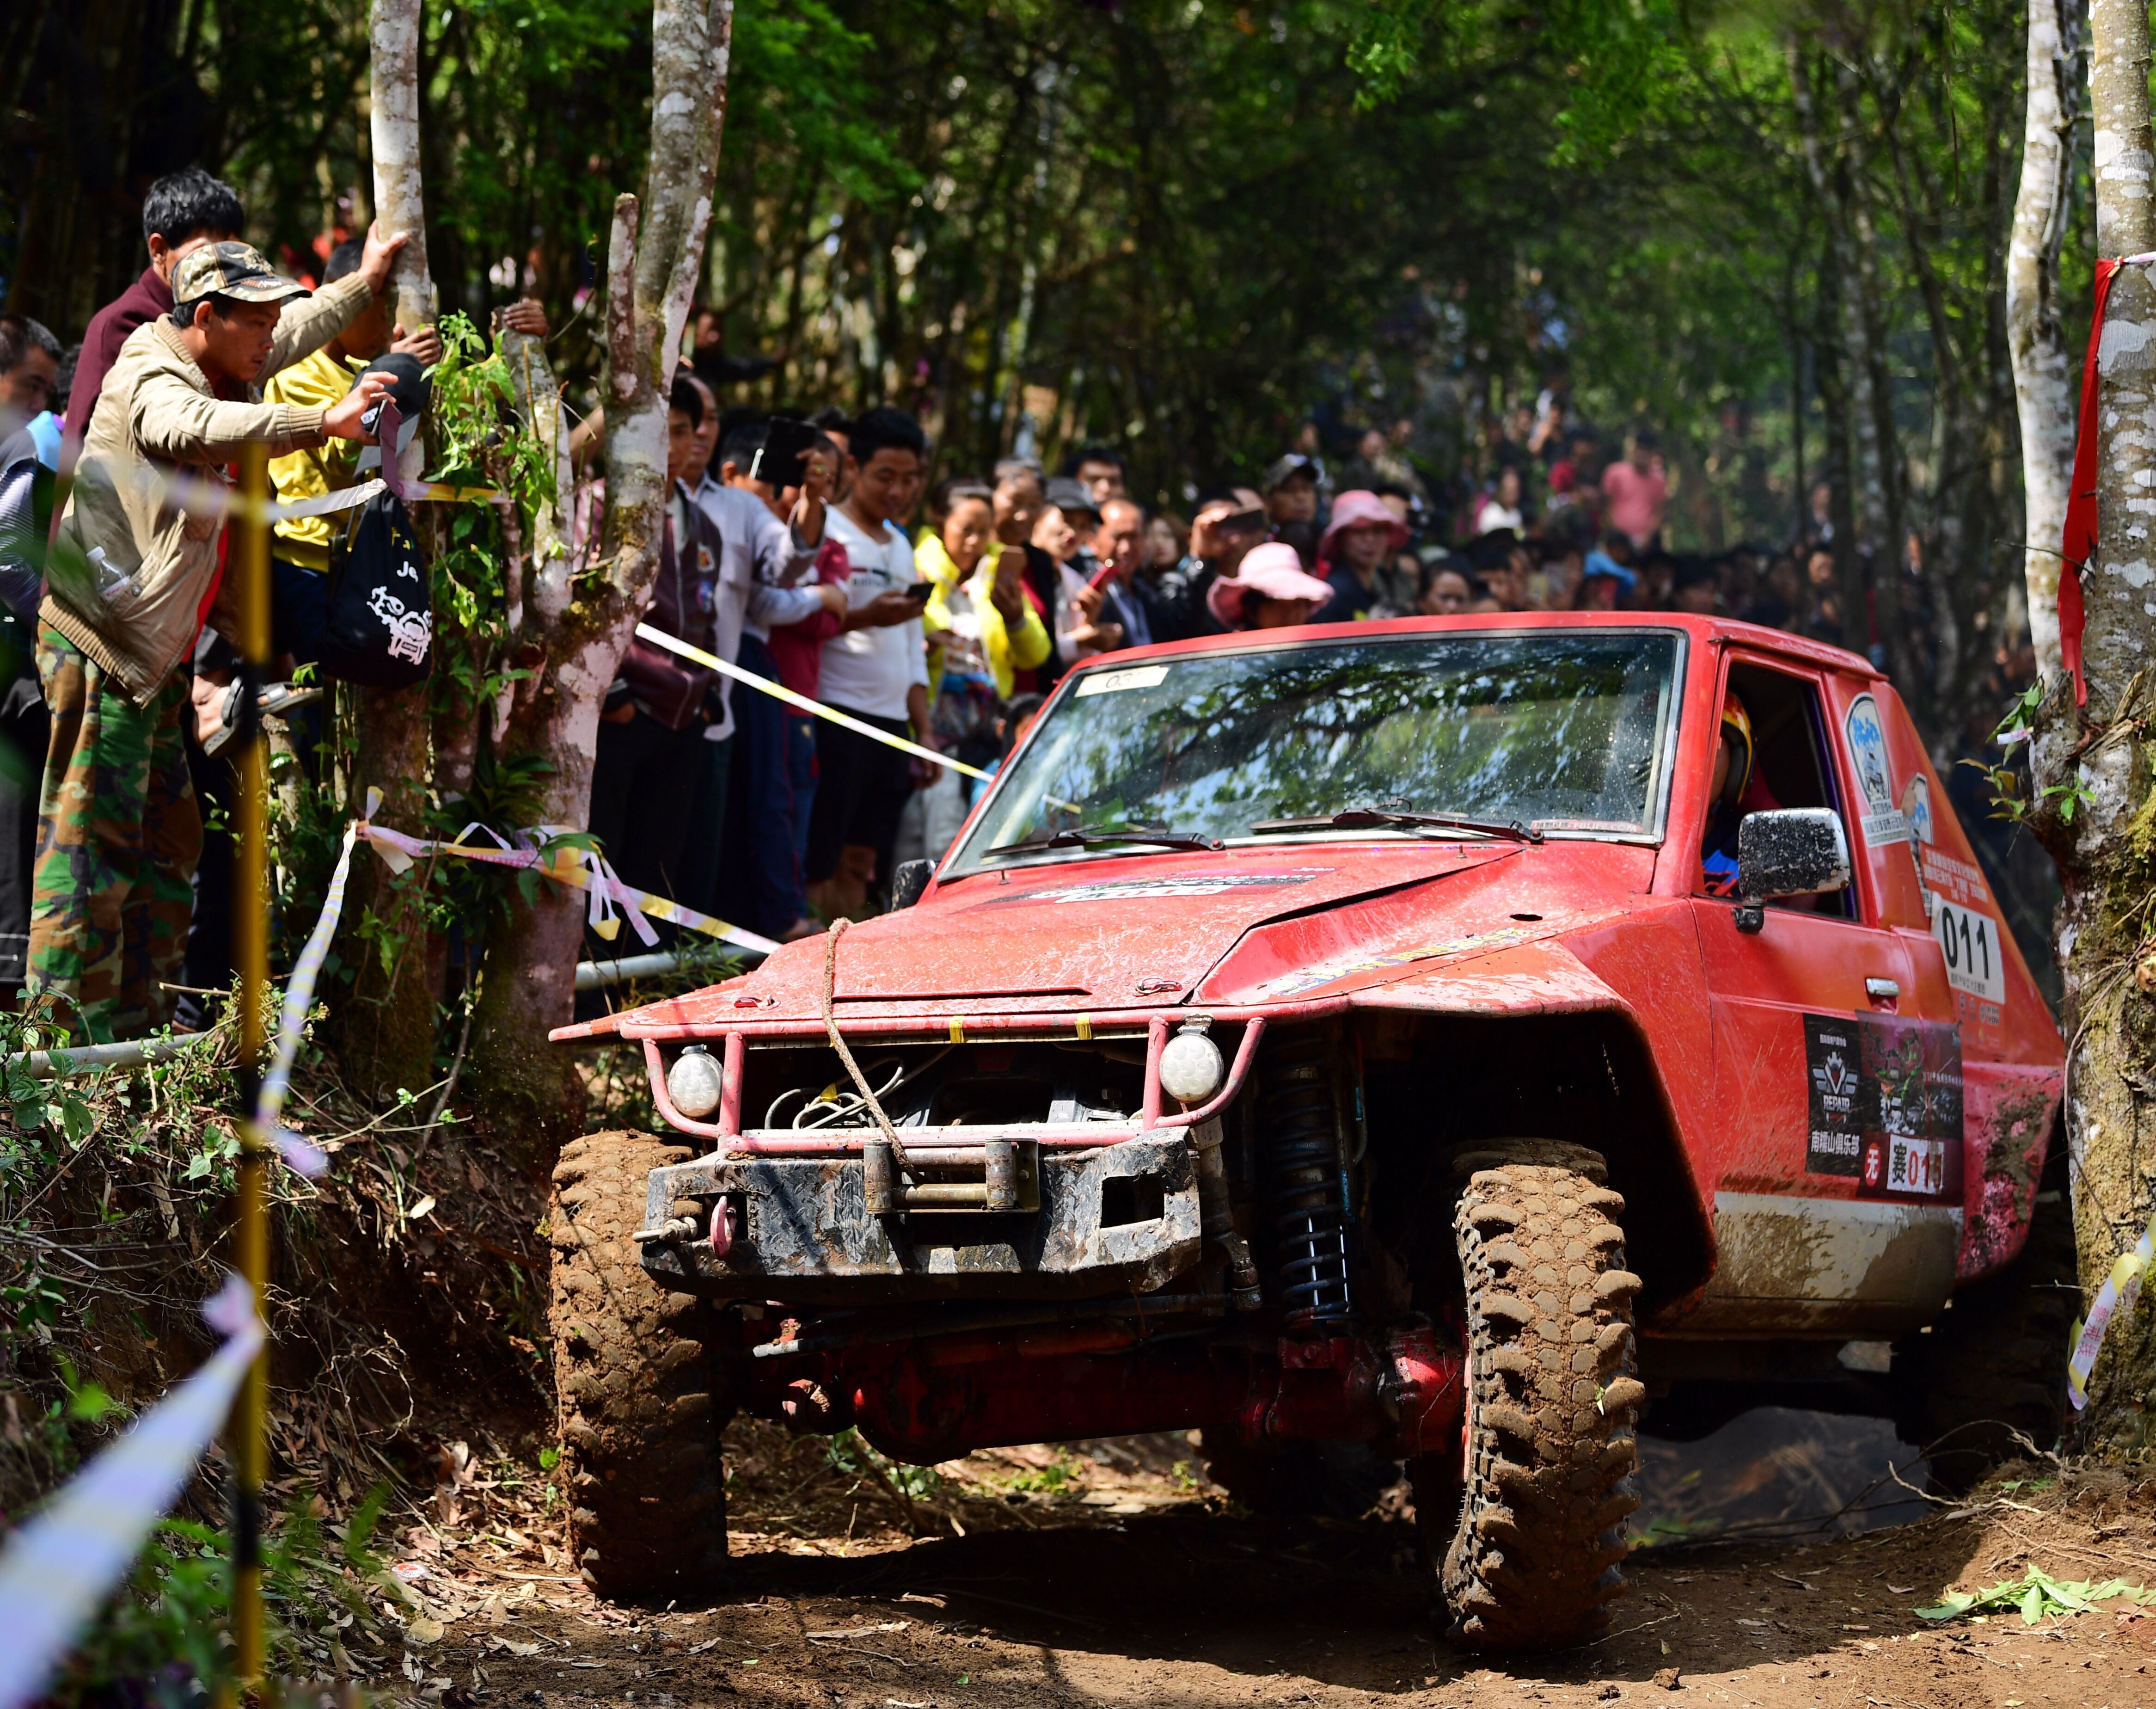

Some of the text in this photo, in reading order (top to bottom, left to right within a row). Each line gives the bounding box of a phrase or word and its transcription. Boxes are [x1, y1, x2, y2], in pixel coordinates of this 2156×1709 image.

[1942, 906, 1989, 981] 011
[1823, 1094, 1850, 1113] REPAIR
[1811, 1130, 1860, 1156] 南糯山俱乐部
[1866, 1149, 1878, 1180] 无
[2077, 1304, 2109, 1357] 警戒线
